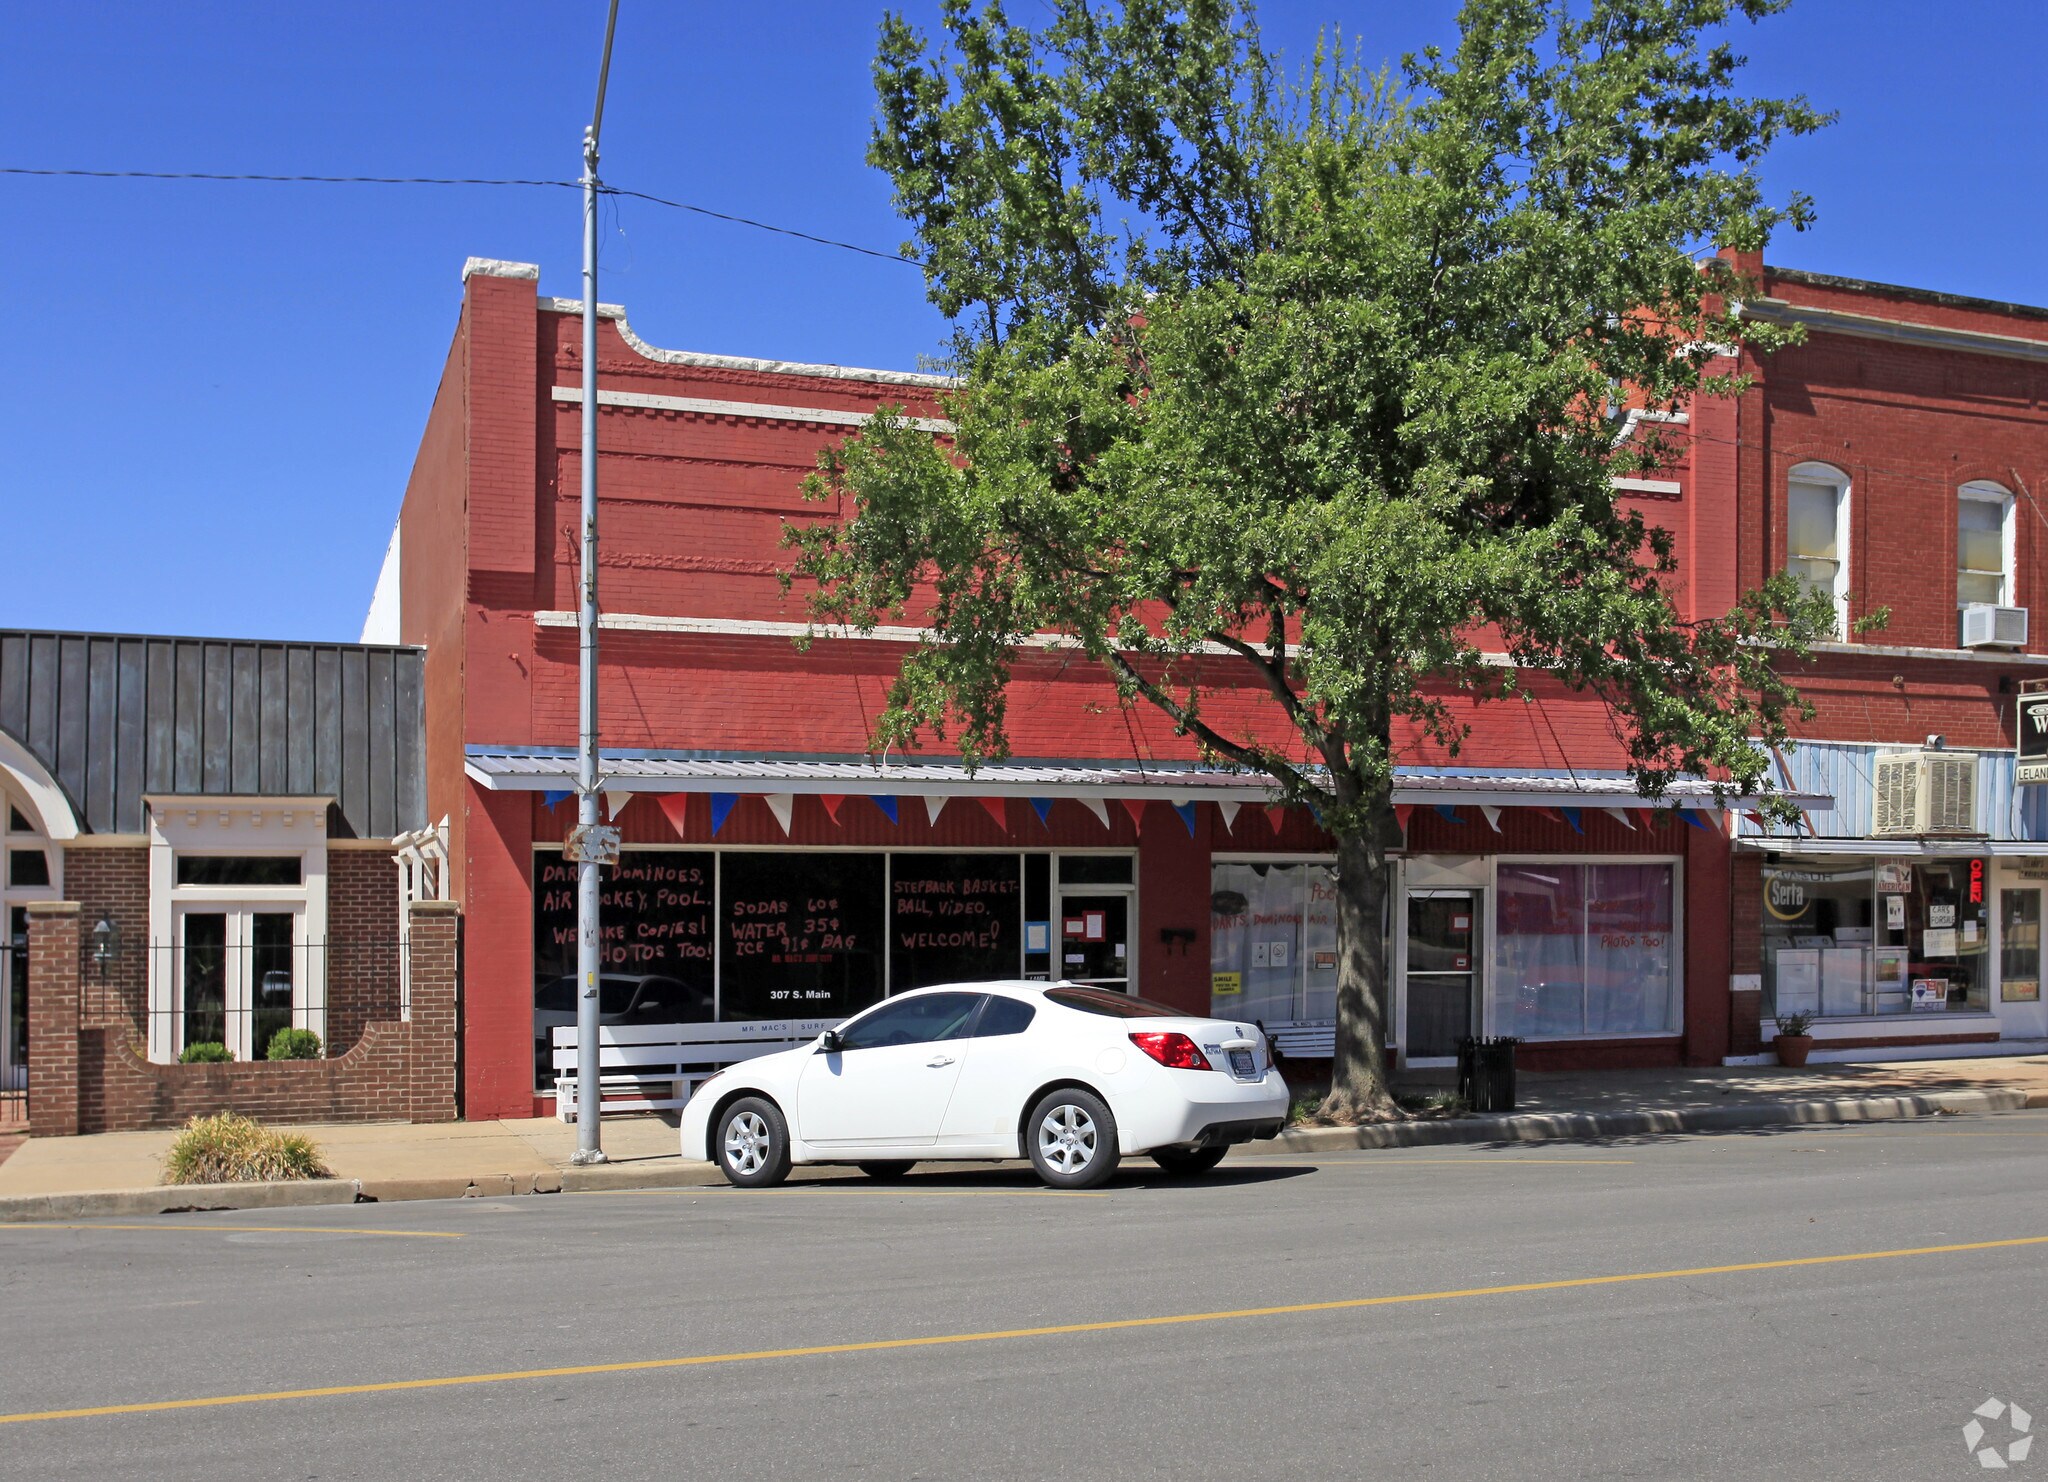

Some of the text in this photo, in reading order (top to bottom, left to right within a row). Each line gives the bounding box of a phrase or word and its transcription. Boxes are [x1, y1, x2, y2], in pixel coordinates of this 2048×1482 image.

[543, 865, 578, 883] DAR
[1970, 859, 1982, 903] OPEN
[600, 890, 647, 913] CKEY,
[1772, 880, 1804, 905] Serta
[553, 927, 578, 944] WE
[731, 921, 787, 939] WATER
[901, 920, 1000, 949] WELCOME!
[736, 941, 764, 956] ICE
[821, 933, 856, 950] BAG
[1601, 935, 1636, 950] PHOTOS
[599, 942, 665, 963] HOTOS
[770, 989, 831, 999] 307 S. Main
[761, 1023, 787, 1032] MAC'S
[801, 1022, 826, 1030] SURF
